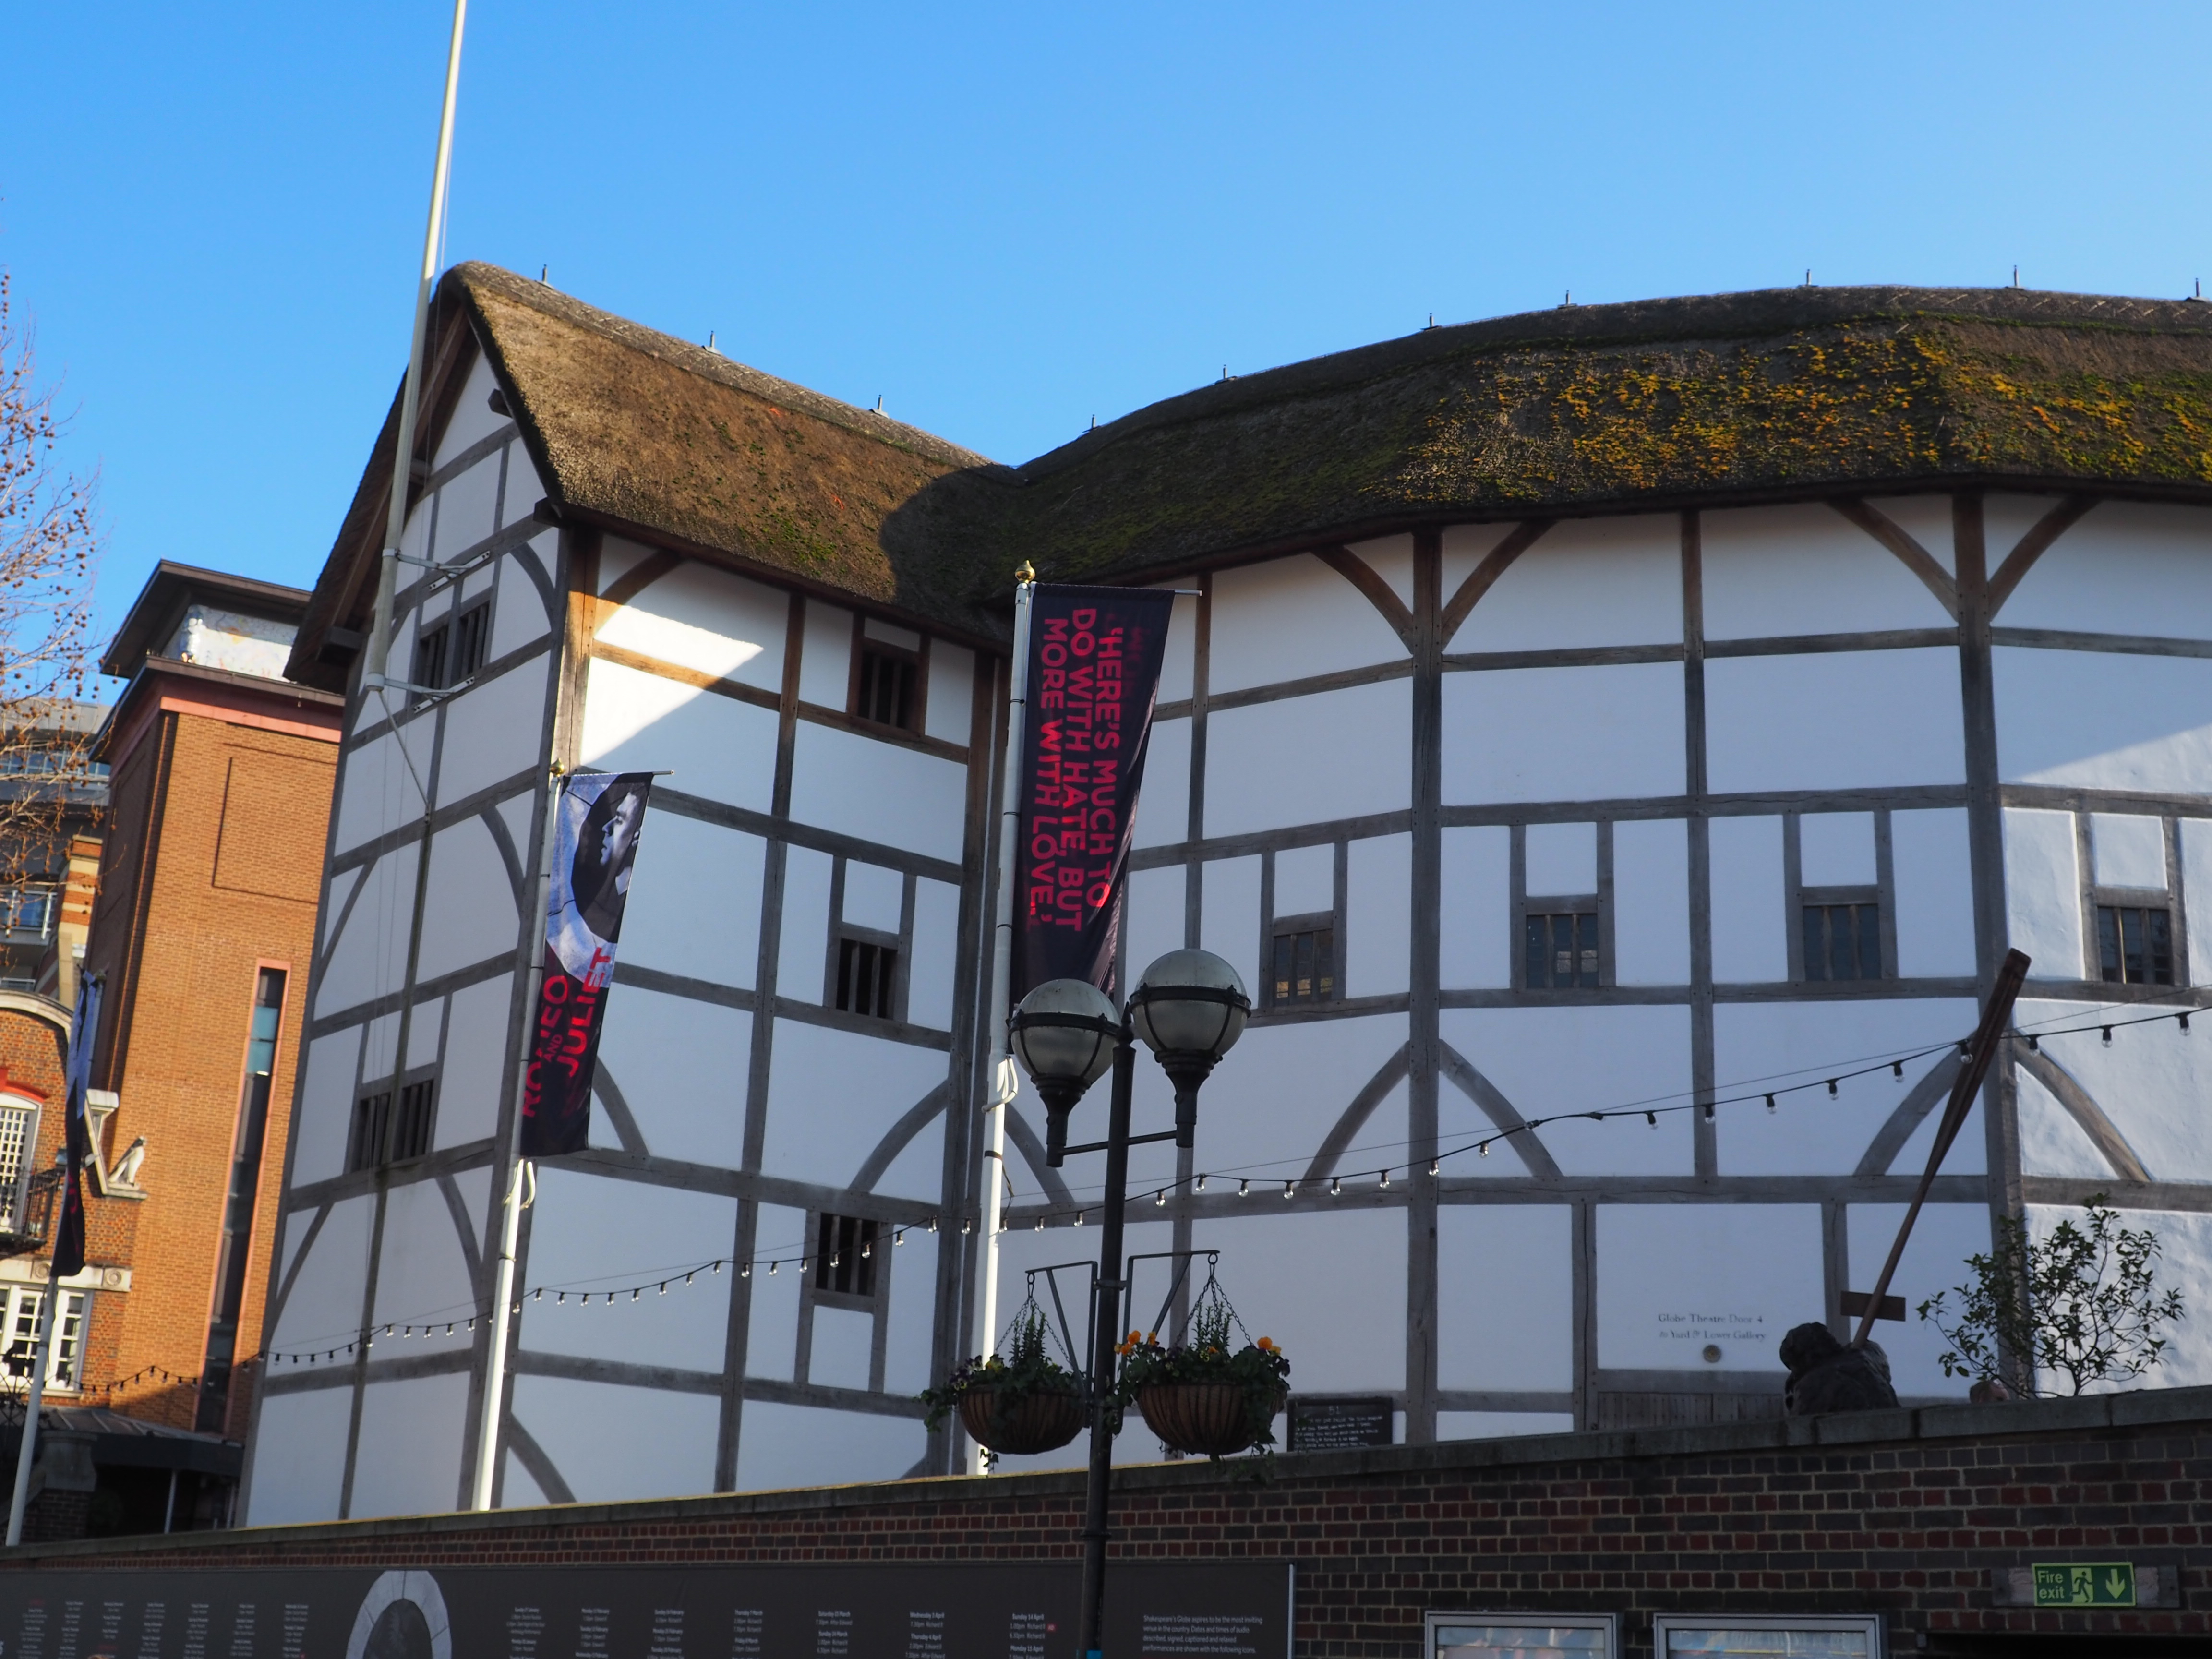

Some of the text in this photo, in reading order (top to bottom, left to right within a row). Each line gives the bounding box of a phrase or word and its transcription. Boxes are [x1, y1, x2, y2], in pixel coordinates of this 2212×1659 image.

[1040, 618, 1068, 709] MORE
[1034, 719, 1063, 806] WITH
[1056, 608, 1097, 931] DO WITH HATE, BUT
[1089, 760, 1118, 855] MUCH
[1086, 861, 1111, 907] TO
[556, 947, 611, 1078] JULIET
[522, 975, 568, 1118] ROEO
[543, 1034, 563, 1063] AND
[1659, 1313, 1686, 1322] Globe
[1689, 1313, 1726, 1323] Theatre
[1729, 1314, 1752, 1323] Door
[1671, 1330, 1690, 1339] Yard
[1704, 1330, 1731, 1339] Lower
[1733, 1330, 1766, 1342] Gallery
[2038, 1570, 2063, 1584] Fire
[2039, 1586, 2064, 1599] exit
